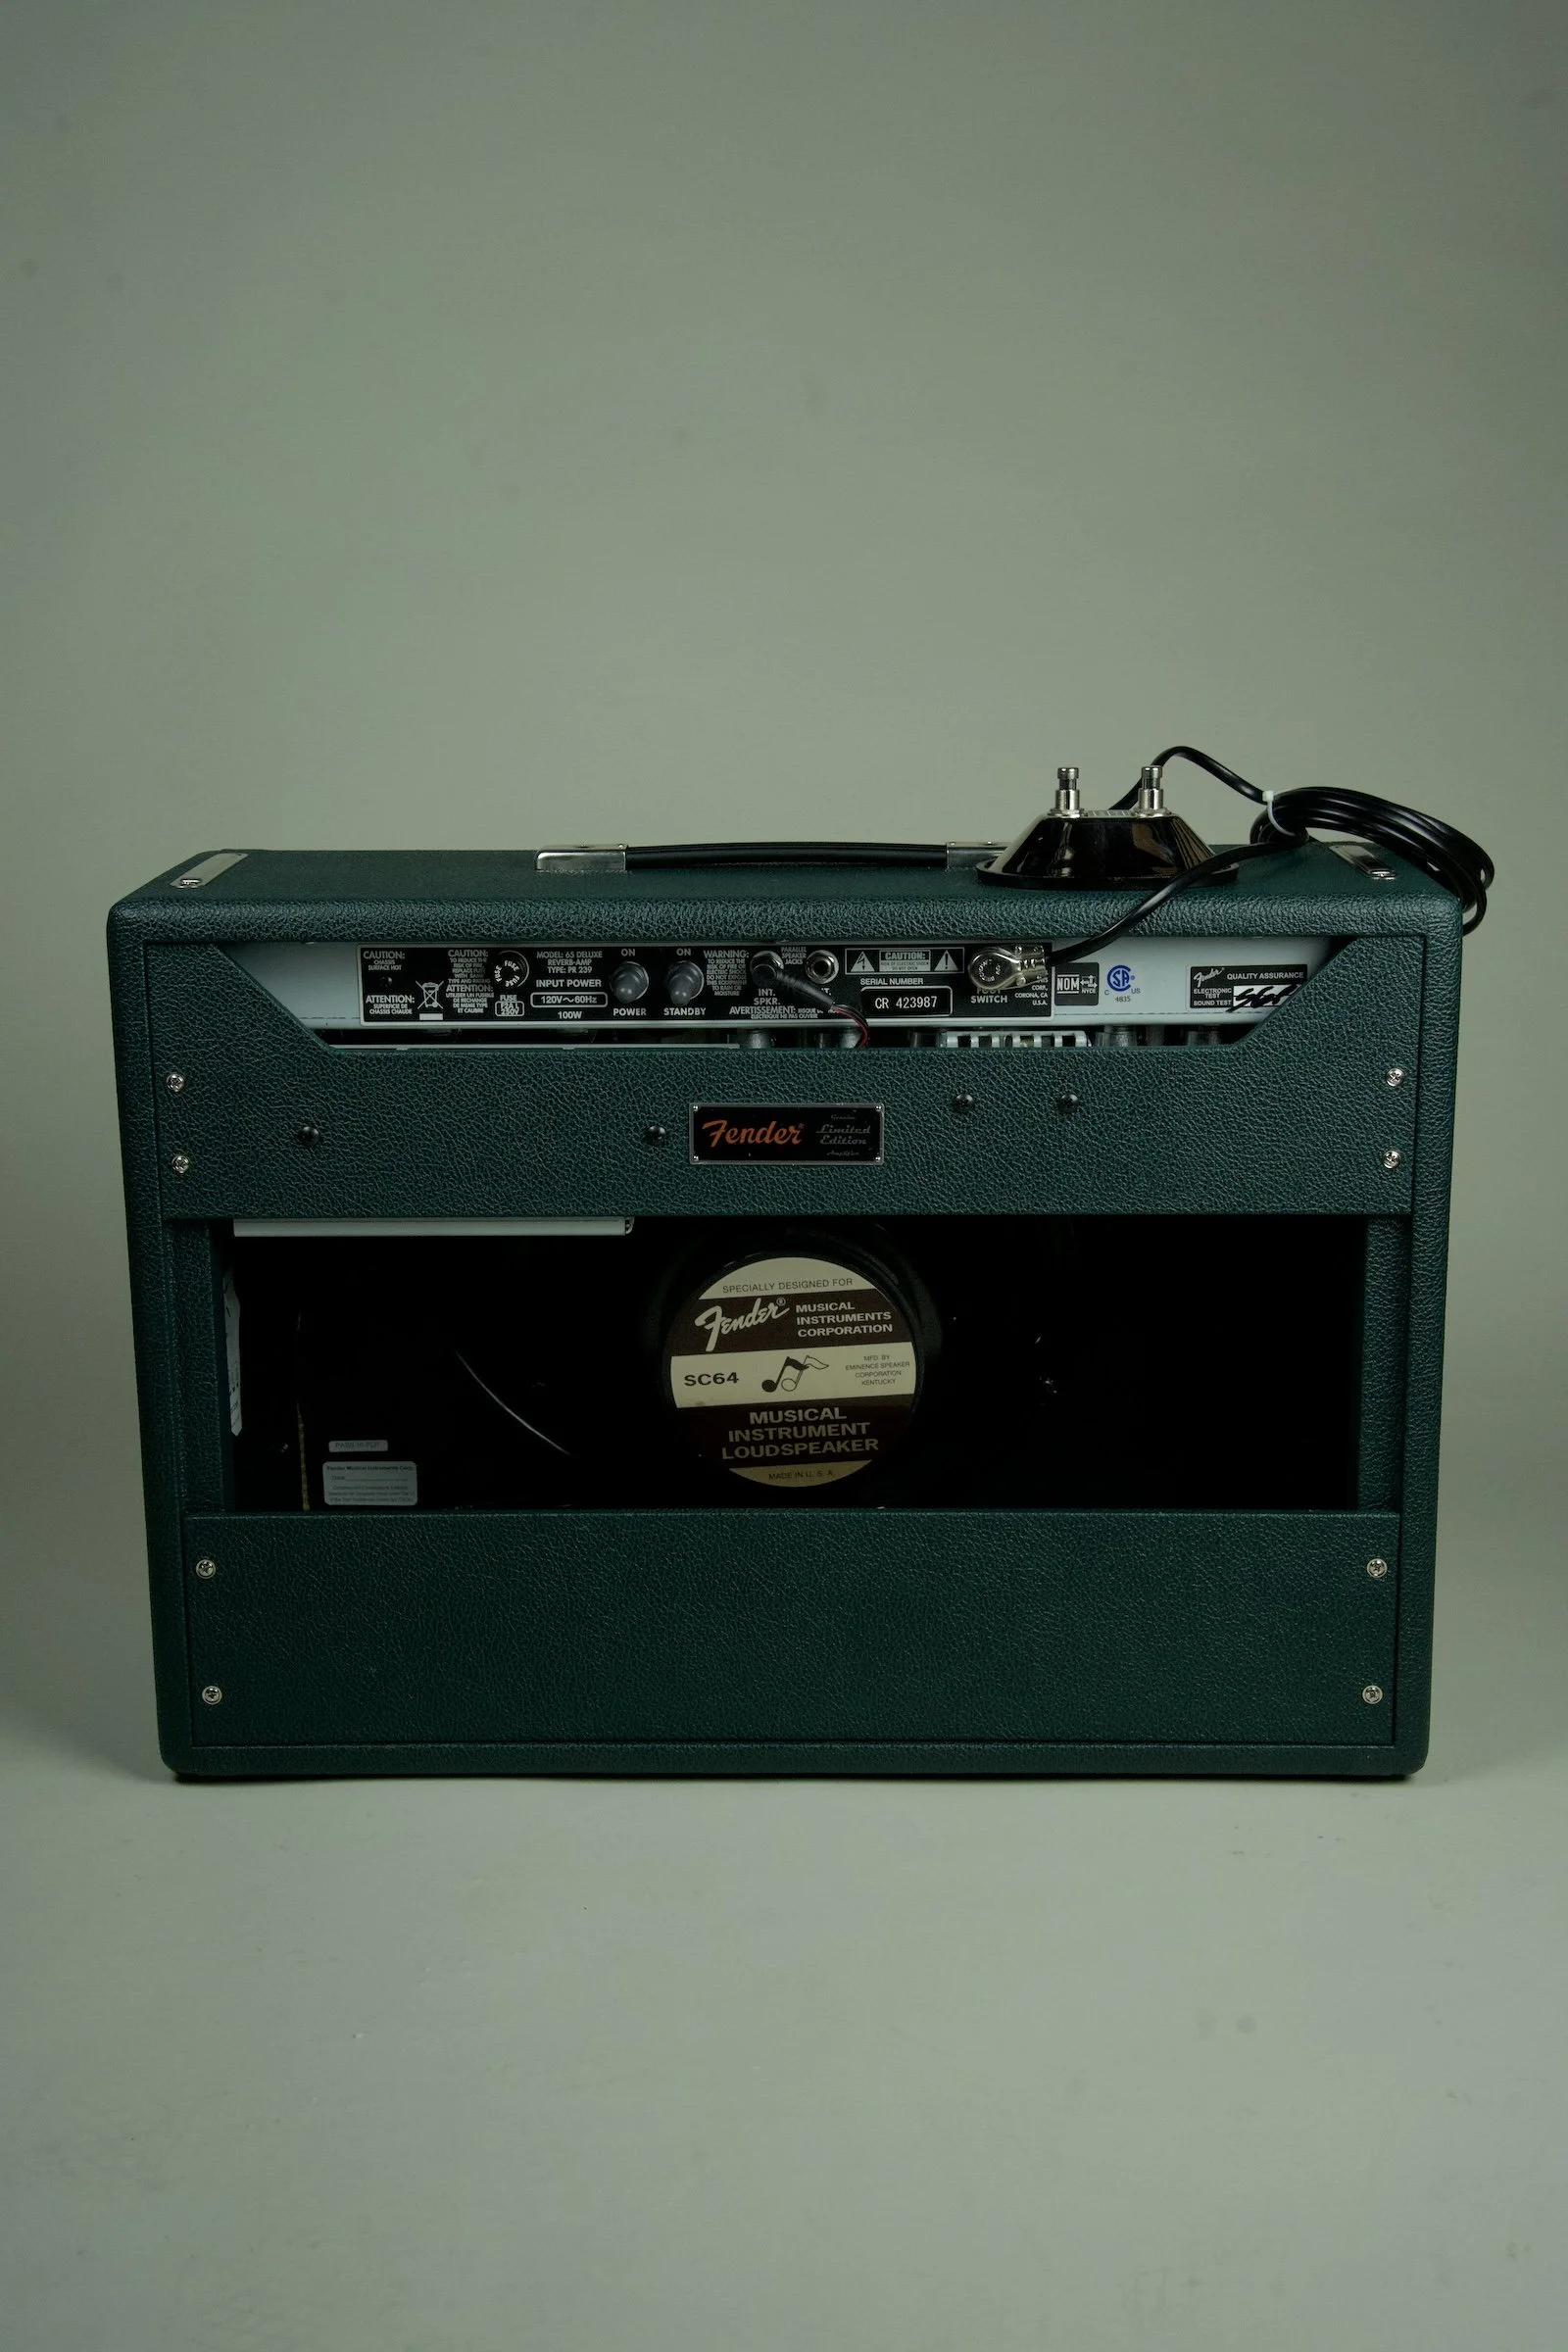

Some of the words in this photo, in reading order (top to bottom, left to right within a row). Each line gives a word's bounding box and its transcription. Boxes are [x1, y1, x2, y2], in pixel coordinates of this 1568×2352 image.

[363, 951, 406, 959] CAUTION:
[448, 949, 489, 957] CAUTION:
[676, 948, 692, 956] ON
[704, 950, 749, 959] WARNING:
[884, 952, 926, 960] CAUTION:
[504, 960, 519, 971] FUSE
[505, 975, 520, 987] FUSE
[536, 979, 565, 987] INPUT
[567, 979, 601, 987] POWER
[1057, 978, 1079, 991] NOM
[366, 995, 415, 1003] ATTENTION:
[875, 998, 889, 1009] CR
[896, 996, 937, 1009] 423987
[971, 995, 1007, 1004] SWITCH
[729, 1006, 796, 1014] AVERTISSEMENT:
[701, 1119, 803, 1148] Fender
[816, 1124, 871, 1134] Limited
[819, 1135, 867, 1145] Edition
[722, 1282, 775, 1294] SPECIALLY
[778, 1279, 830, 1290] DESIGNED
[833, 1278, 853, 1287] FOR
[796, 1301, 855, 1313] MUSICAL
[796, 1311, 892, 1325] INSTRUMENTS
[694, 1298, 790, 1352] Fender
[798, 1323, 893, 1338] CORPORATION
[684, 1372, 739, 1386] SC64
[749, 1407, 847, 1424] MUSICAL
[729, 1422, 870, 1442] INSTRUMENT
[722, 1439, 879, 1459] LOUDSPEAKER
[768, 1472, 792, 1480] MADE
